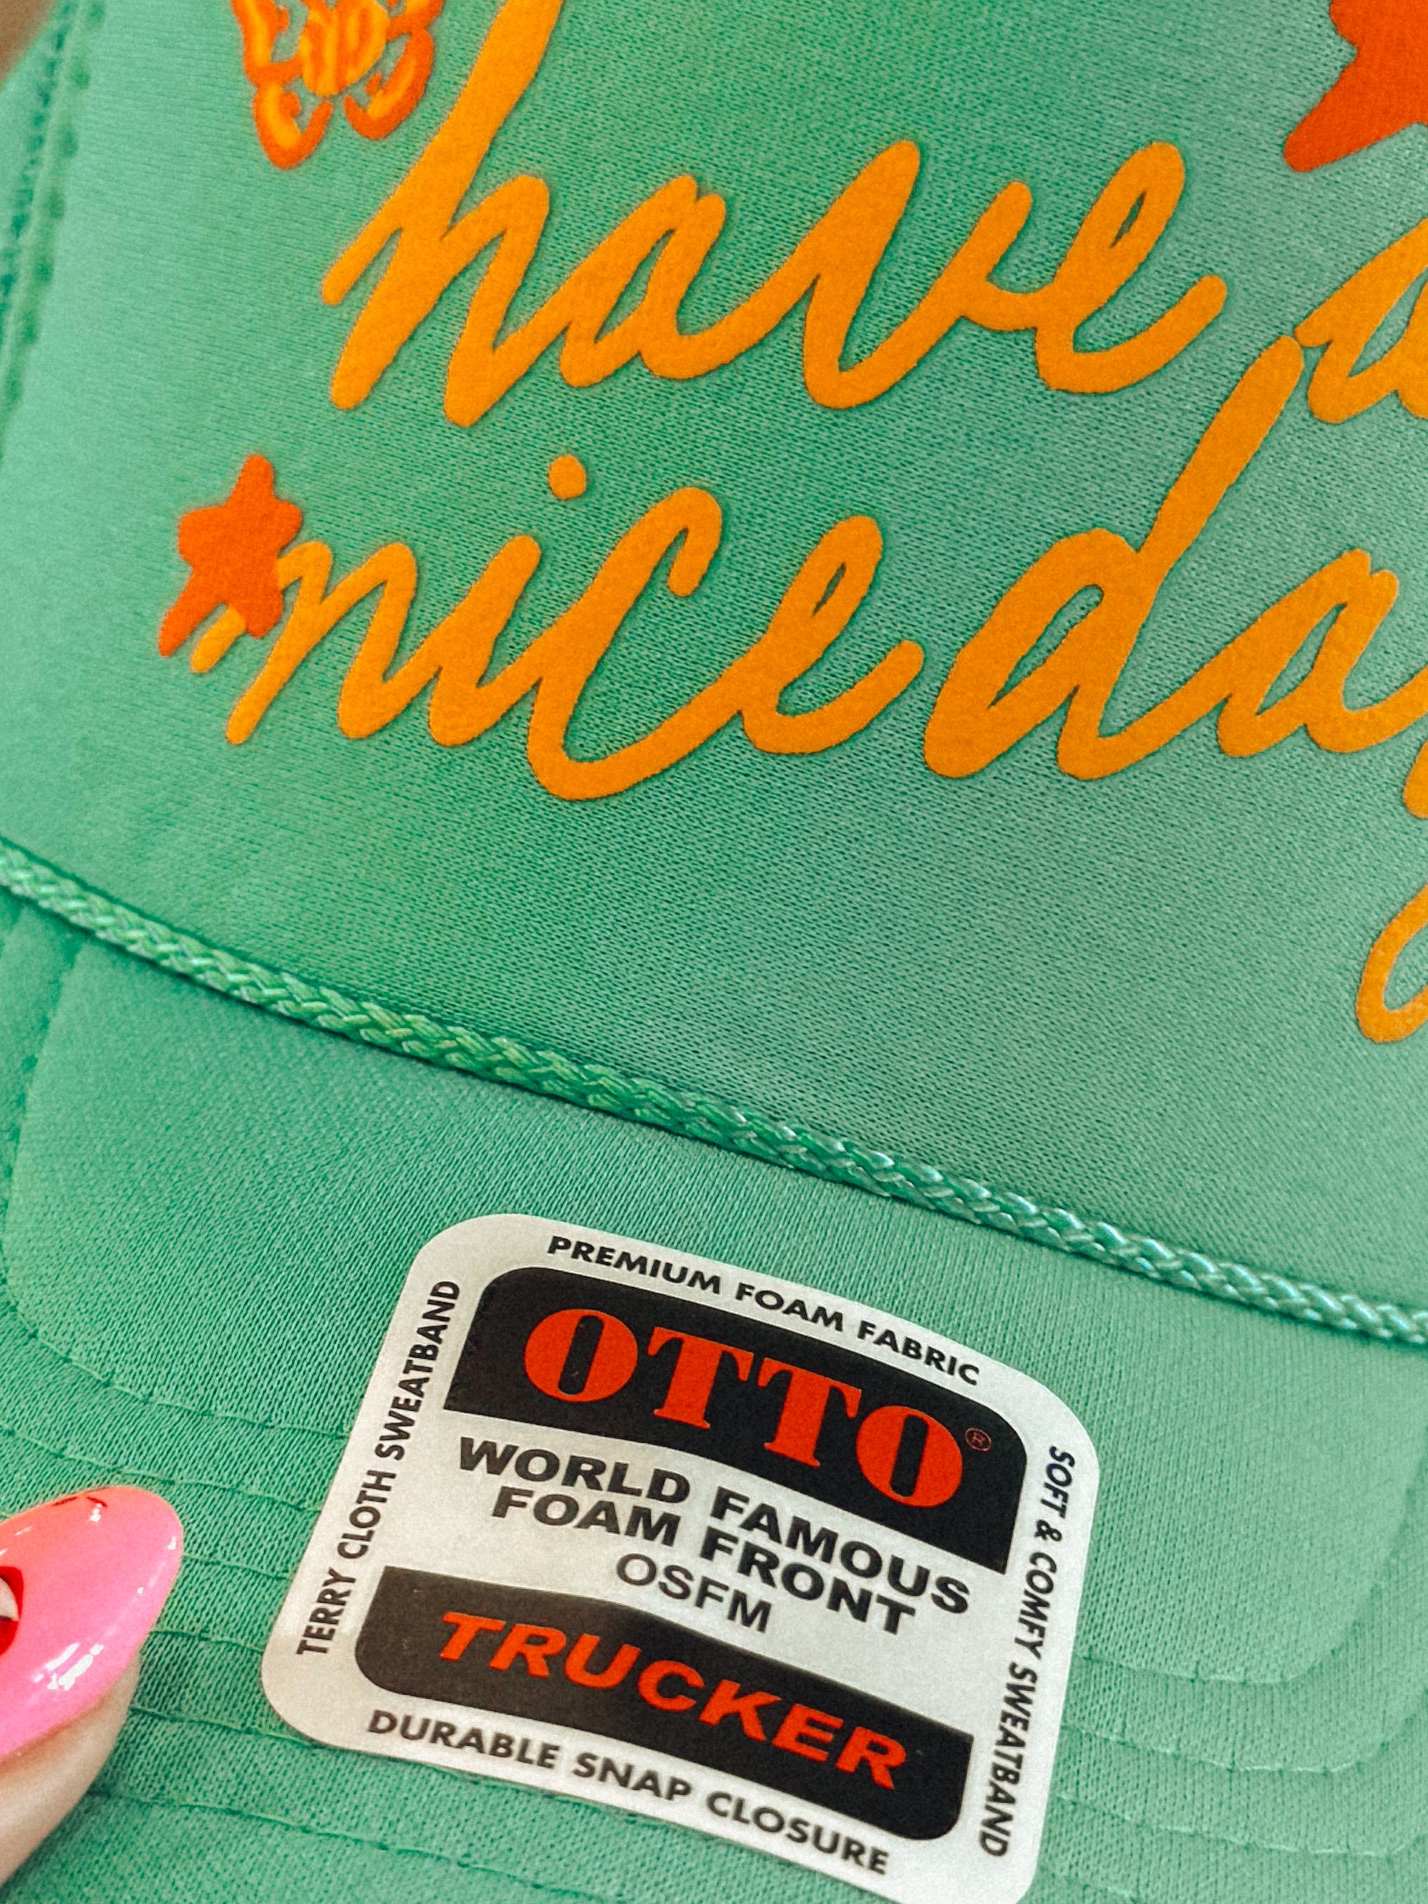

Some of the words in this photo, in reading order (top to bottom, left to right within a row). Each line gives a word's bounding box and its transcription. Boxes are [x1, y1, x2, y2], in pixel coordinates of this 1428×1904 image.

[191, 454, 925, 801] nice
[547, 1236, 721, 1294] PREMIUM
[734, 1283, 844, 1332] FOAM
[857, 1320, 980, 1386] FABRIC
[297, 1566, 357, 1656] TERRY
[337, 1469, 397, 1561] CLOTH
[376, 1280, 460, 1460] SWEATBAND
[524, 1308, 964, 1509] OTTO
[1030, 1444, 1076, 1522] SOFT
[458, 1437, 690, 1505] WORLD
[710, 1493, 970, 1614] FAMOUS
[492, 1487, 679, 1545] FOAM
[699, 1533, 915, 1634] FRONT
[616, 1553, 772, 1633] OSFM
[1014, 1551, 1061, 1658] COMFY
[1036, 1521, 1061, 1539] &
[440, 1611, 906, 1790] TRUCKER
[979, 1661, 1039, 1858] SWEATBAND
[368, 1709, 560, 1768] DURABLE
[572, 1751, 693, 1803] SNAP
[706, 1790, 890, 1875] CLOSURE
